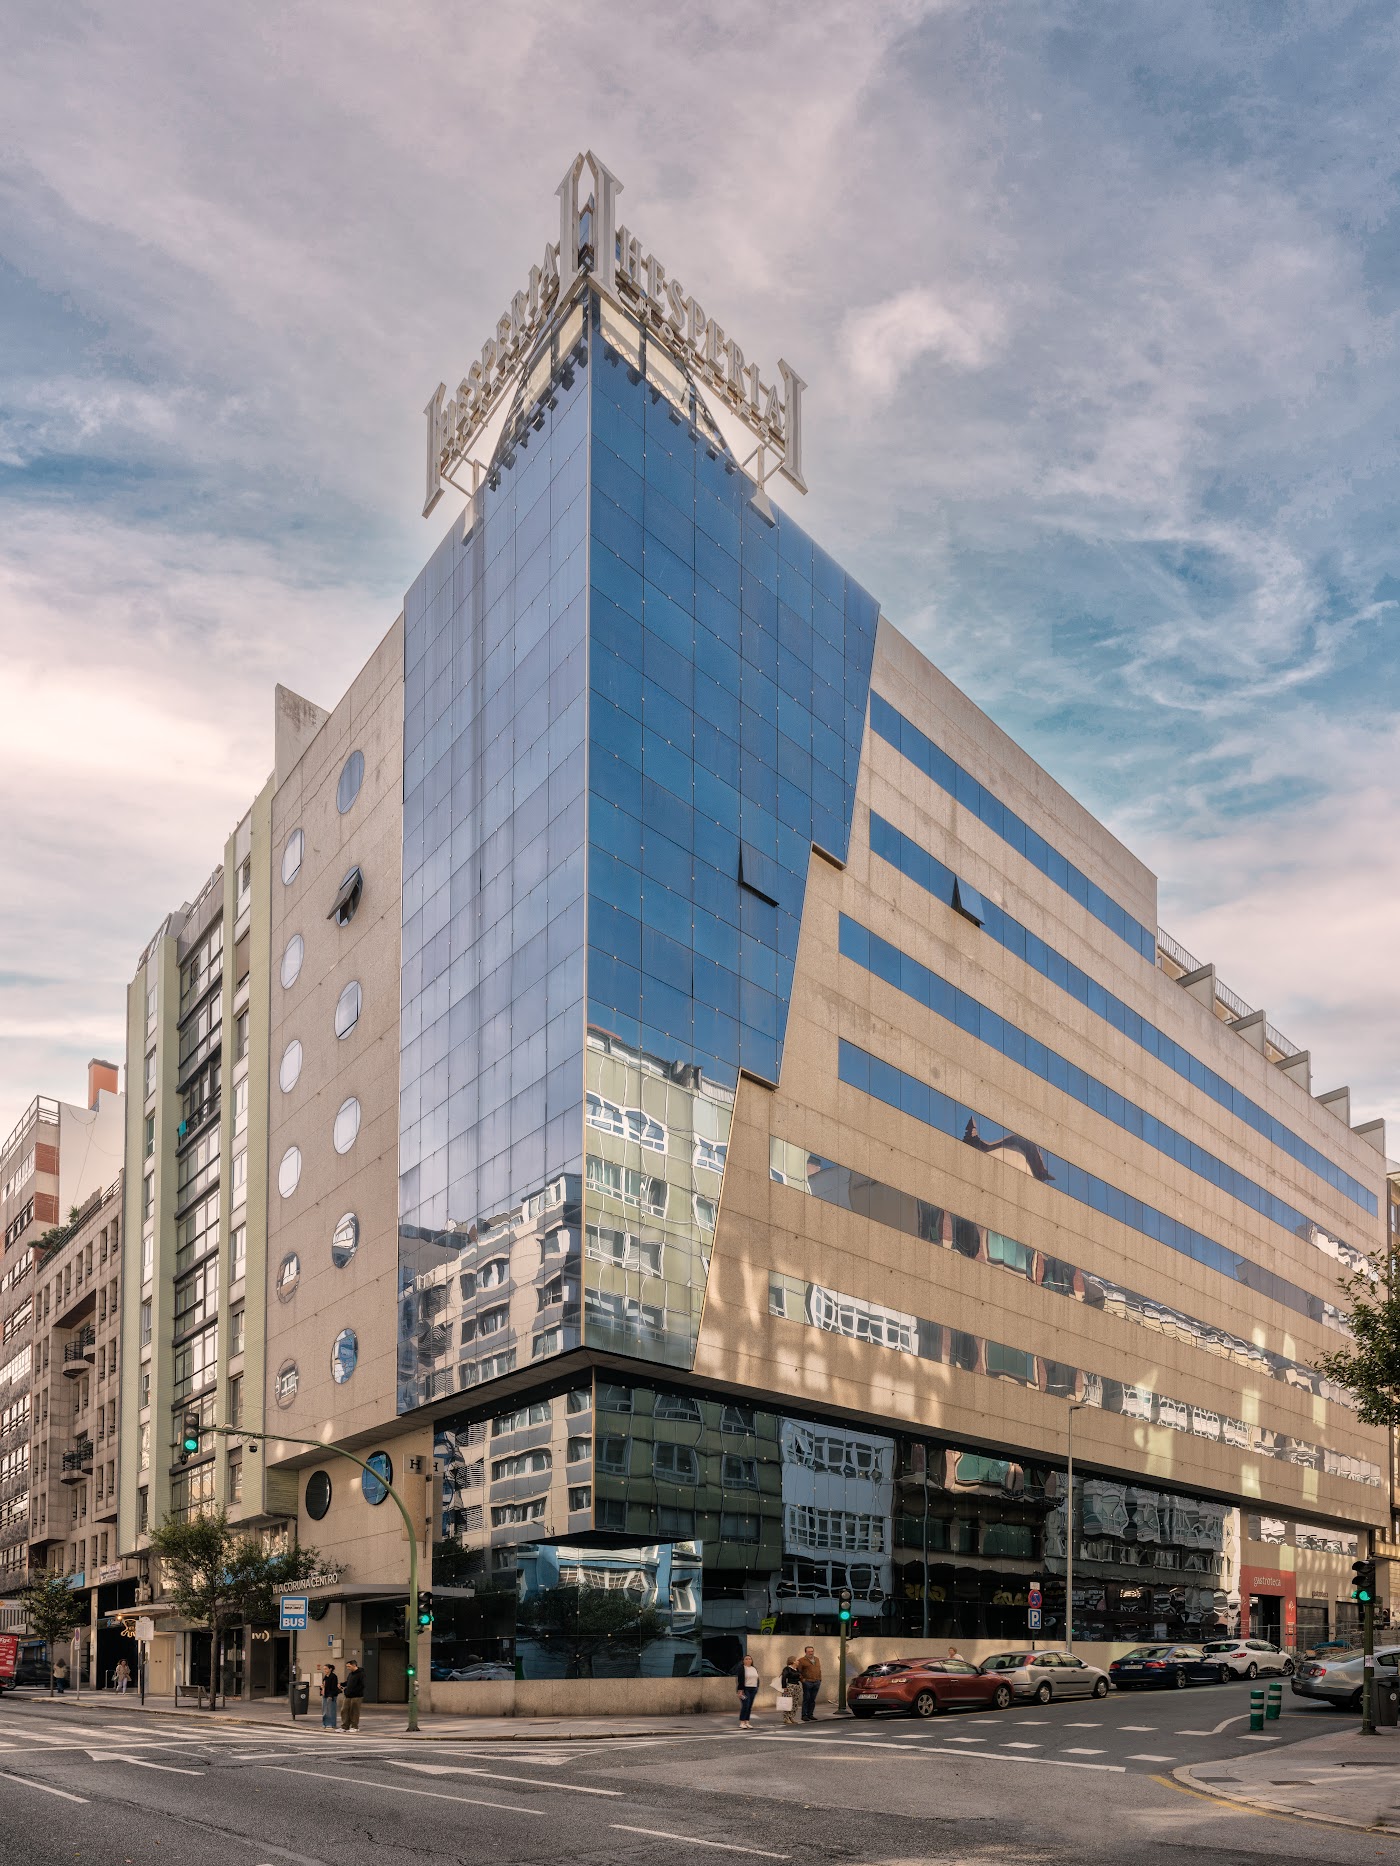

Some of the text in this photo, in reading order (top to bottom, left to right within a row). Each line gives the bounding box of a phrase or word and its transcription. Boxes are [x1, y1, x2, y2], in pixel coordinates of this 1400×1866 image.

[615, 224, 784, 436] HESPERIA
[440, 241, 560, 460] HESPERIA
[409, 1459, 421, 1470] H
[310, 1573, 338, 1588] CENTRO
[1253, 1576, 1282, 1587] gastroteca
[282, 1618, 305, 1627] BUS
[1032, 1611, 1039, 1626] P
